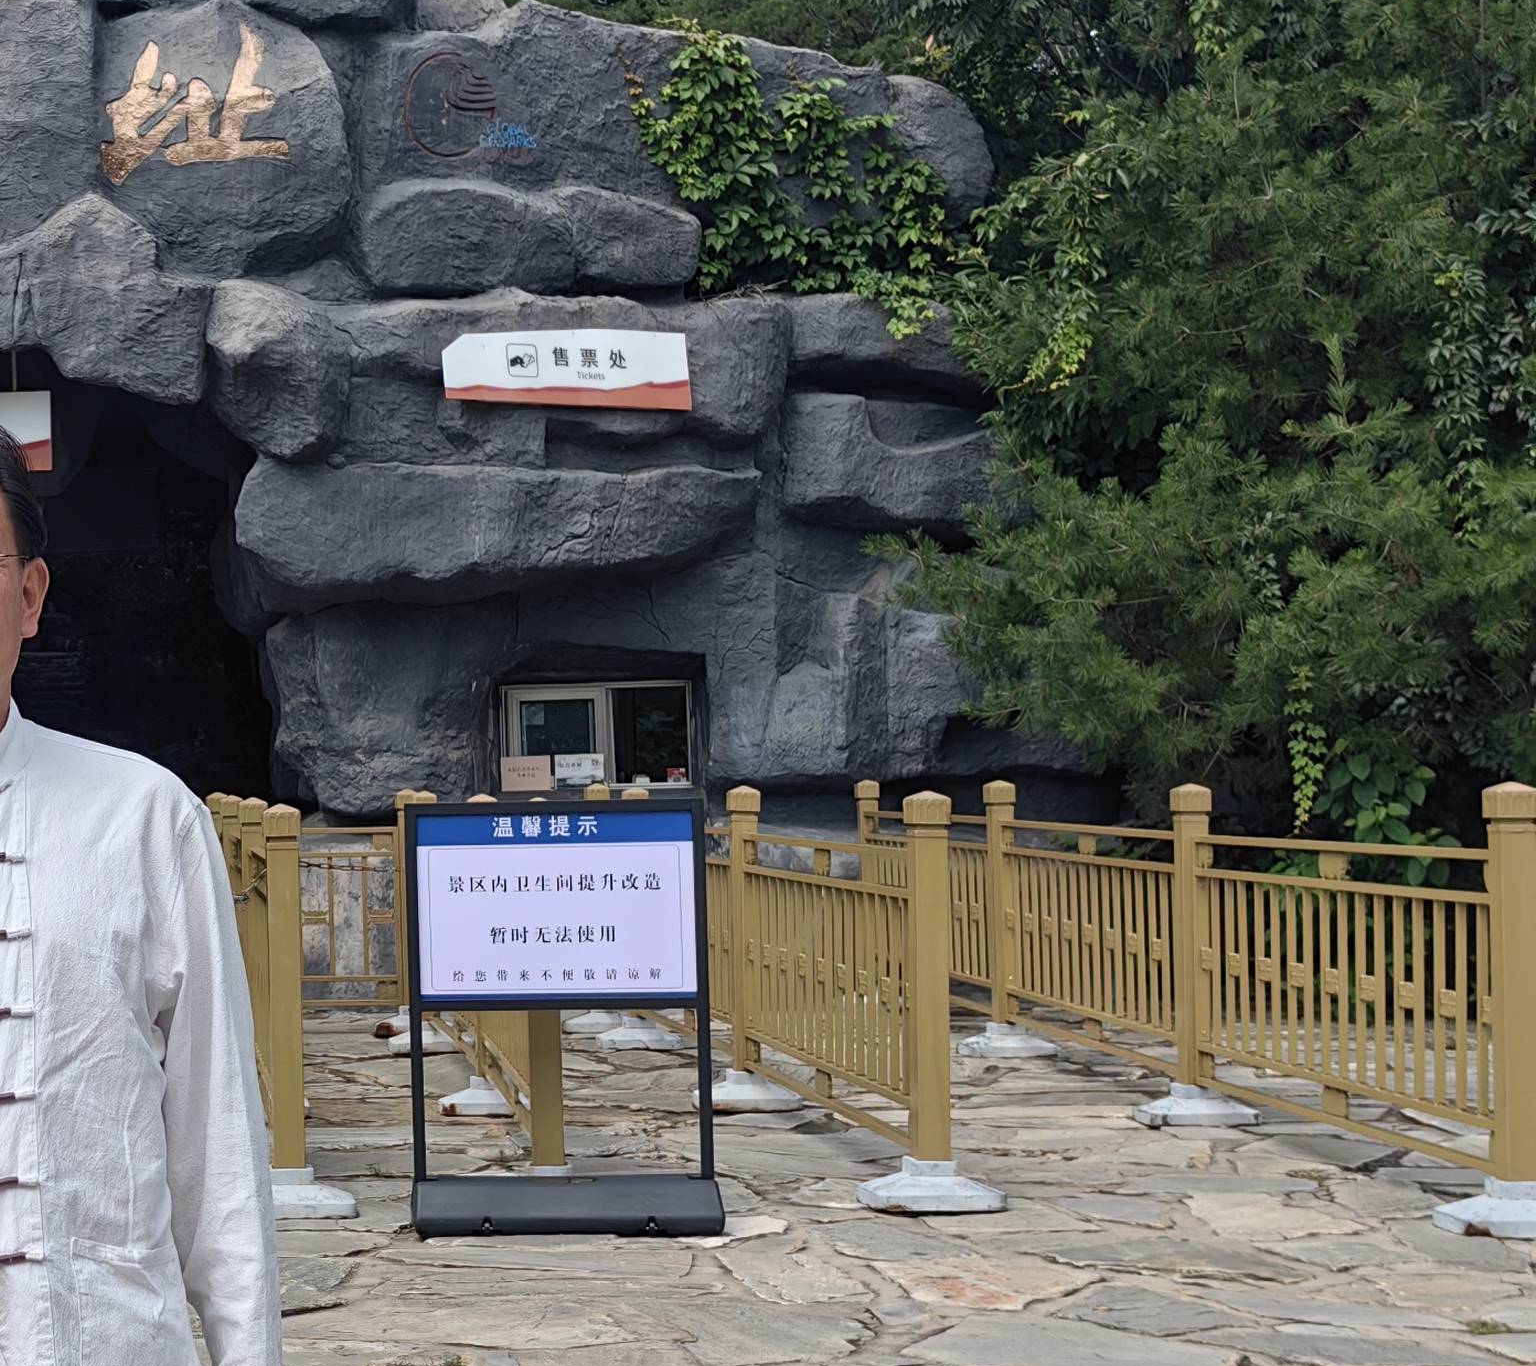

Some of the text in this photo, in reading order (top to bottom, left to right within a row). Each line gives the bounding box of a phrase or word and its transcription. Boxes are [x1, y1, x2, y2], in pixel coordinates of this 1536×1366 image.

[552, 346, 627, 369] 售票处
[577, 371, 606, 381] Tickets
[492, 815, 598, 838] 温馨提示
[448, 872, 662, 893] 景区内卫生间提升改造
[490, 925, 616, 944] 暂时无法使用
[452, 967, 662, 983] 给您带来不便敬请谅解
